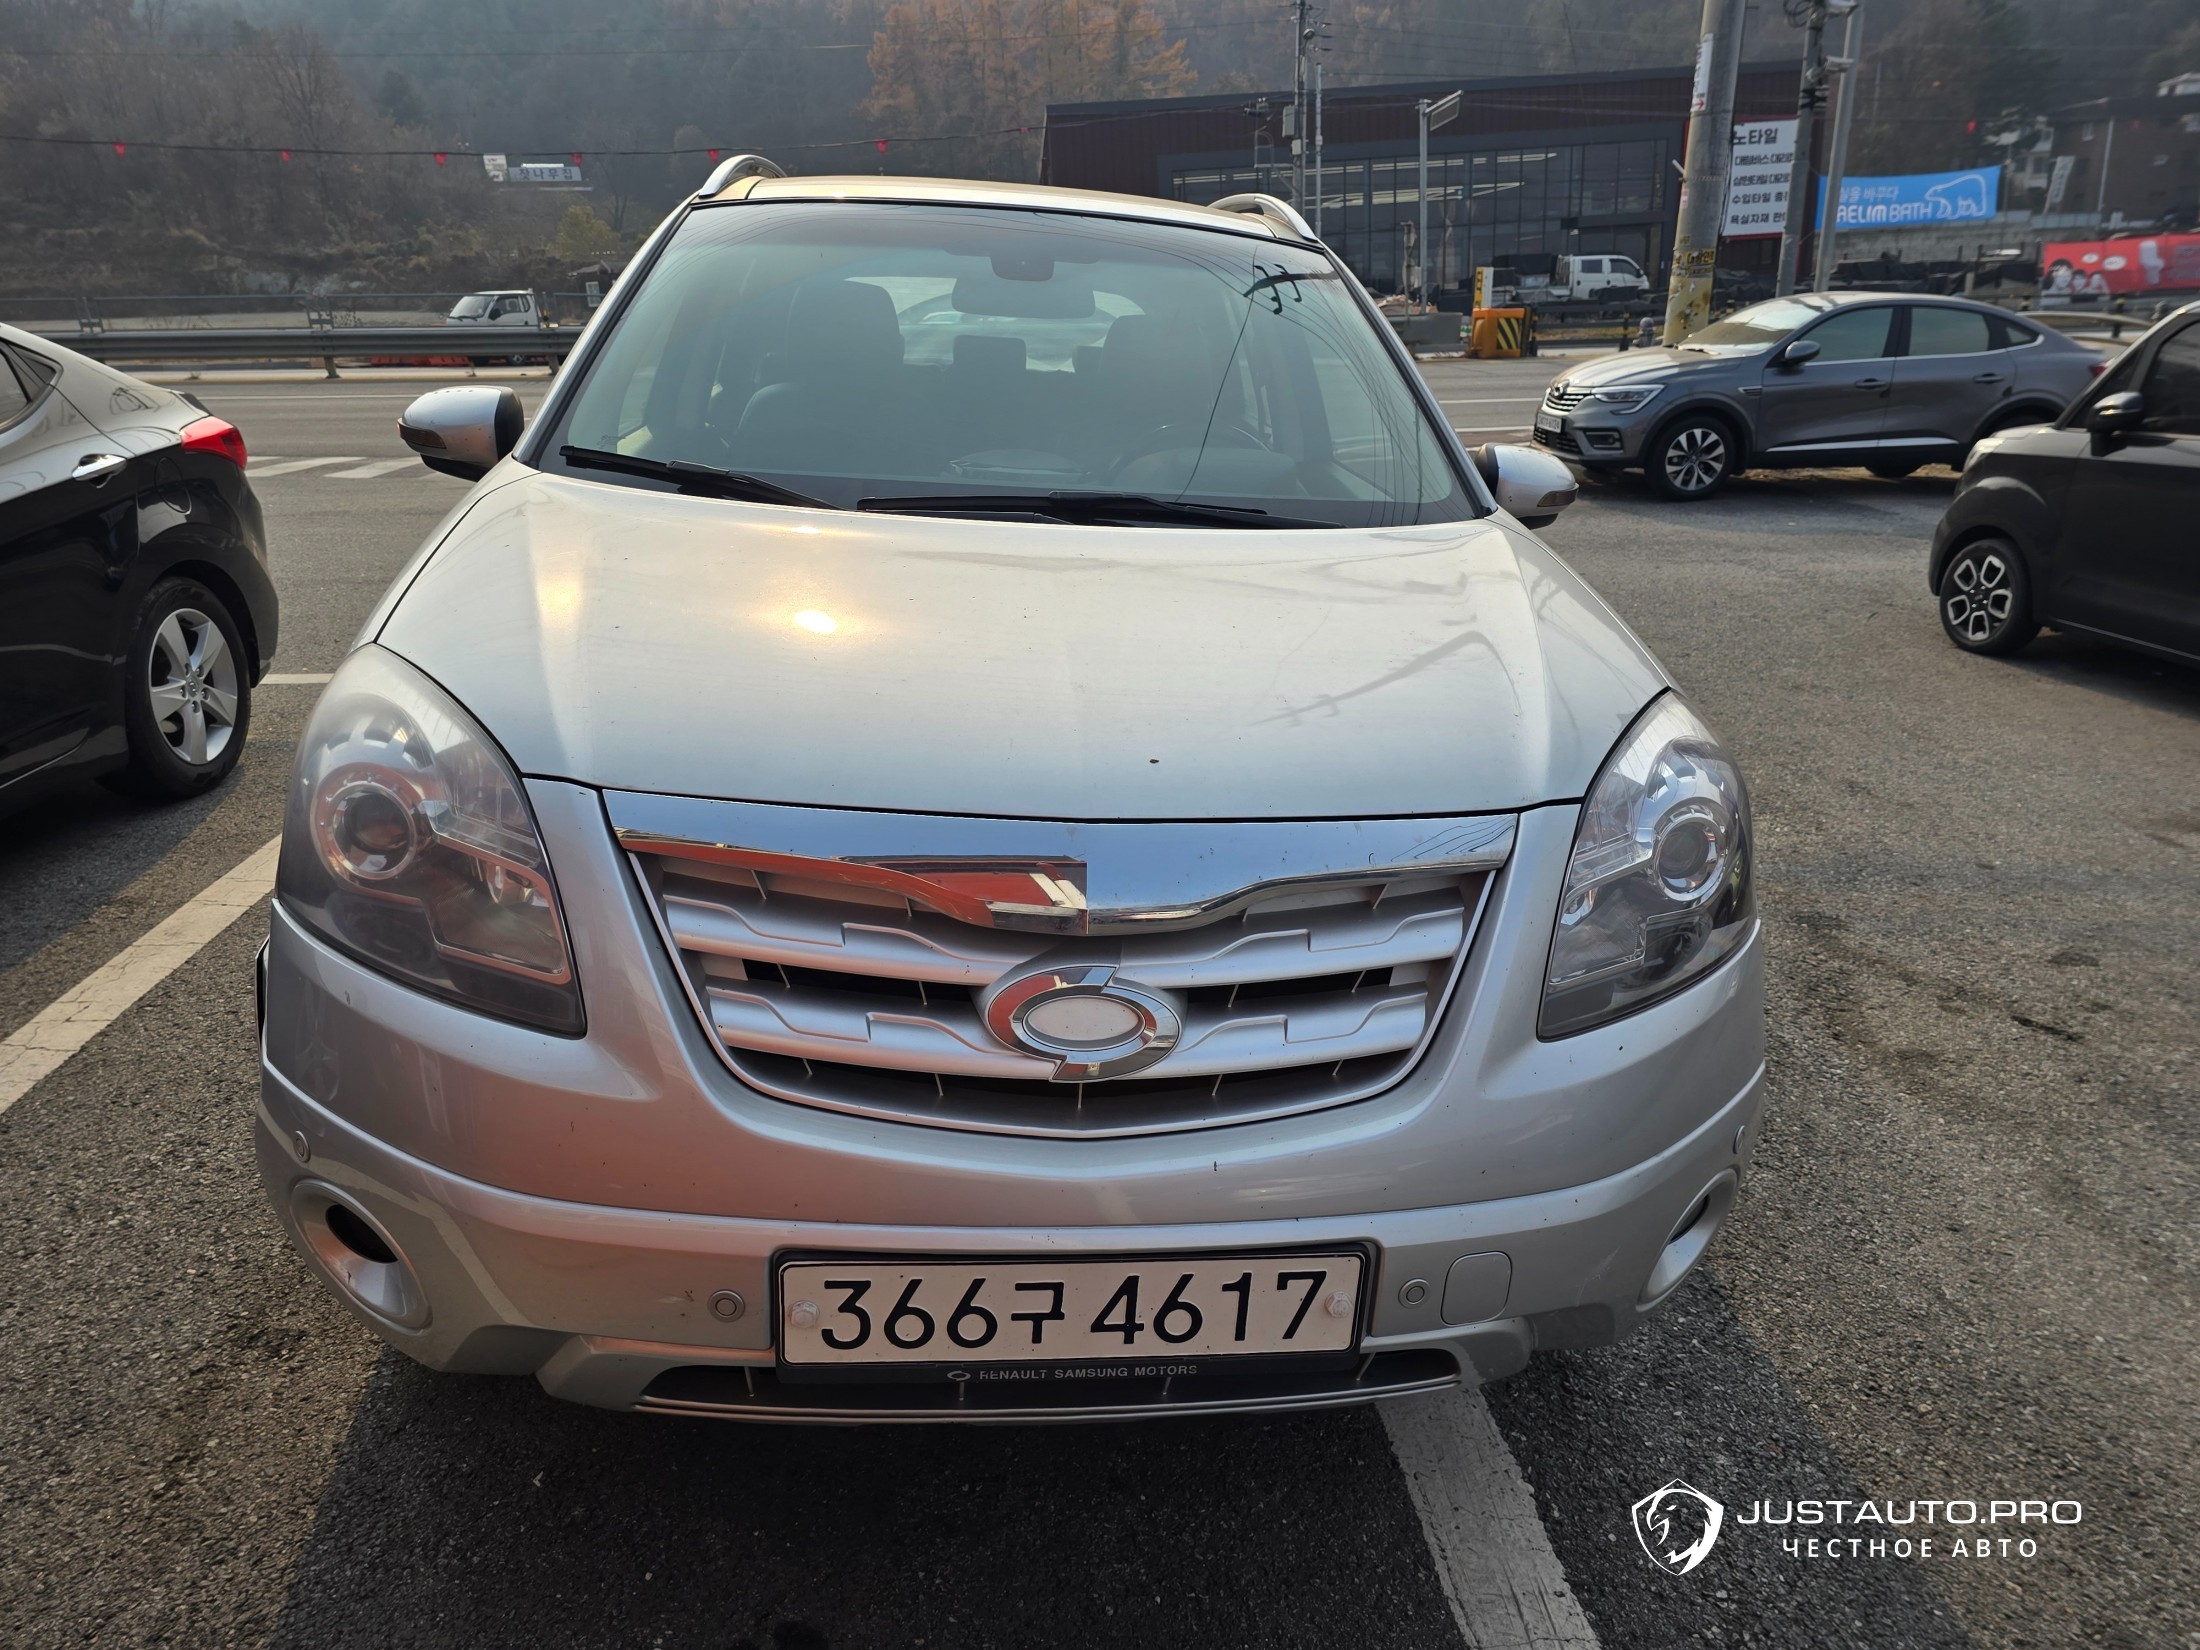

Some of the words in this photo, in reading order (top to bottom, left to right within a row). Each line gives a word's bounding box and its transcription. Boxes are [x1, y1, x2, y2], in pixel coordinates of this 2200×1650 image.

[1732, 127, 1778, 145] 노타일
[1732, 192, 1771, 204] 수입타일
[1863, 186, 1899, 202] 바꾸다
[1730, 212, 1769, 225] 욕실자재
[1773, 211, 1785, 223] 판
[1837, 204, 1887, 223] AELIM
[1889, 201, 1933, 222] BATH
[821, 1278, 1065, 1350] 366구
[1090, 1271, 1328, 1346] 4617
[979, 1369, 1048, 1381] RENAULT
[1054, 1366, 1129, 1379] SAMSUNG
[1134, 1364, 1198, 1376] MOTORS
